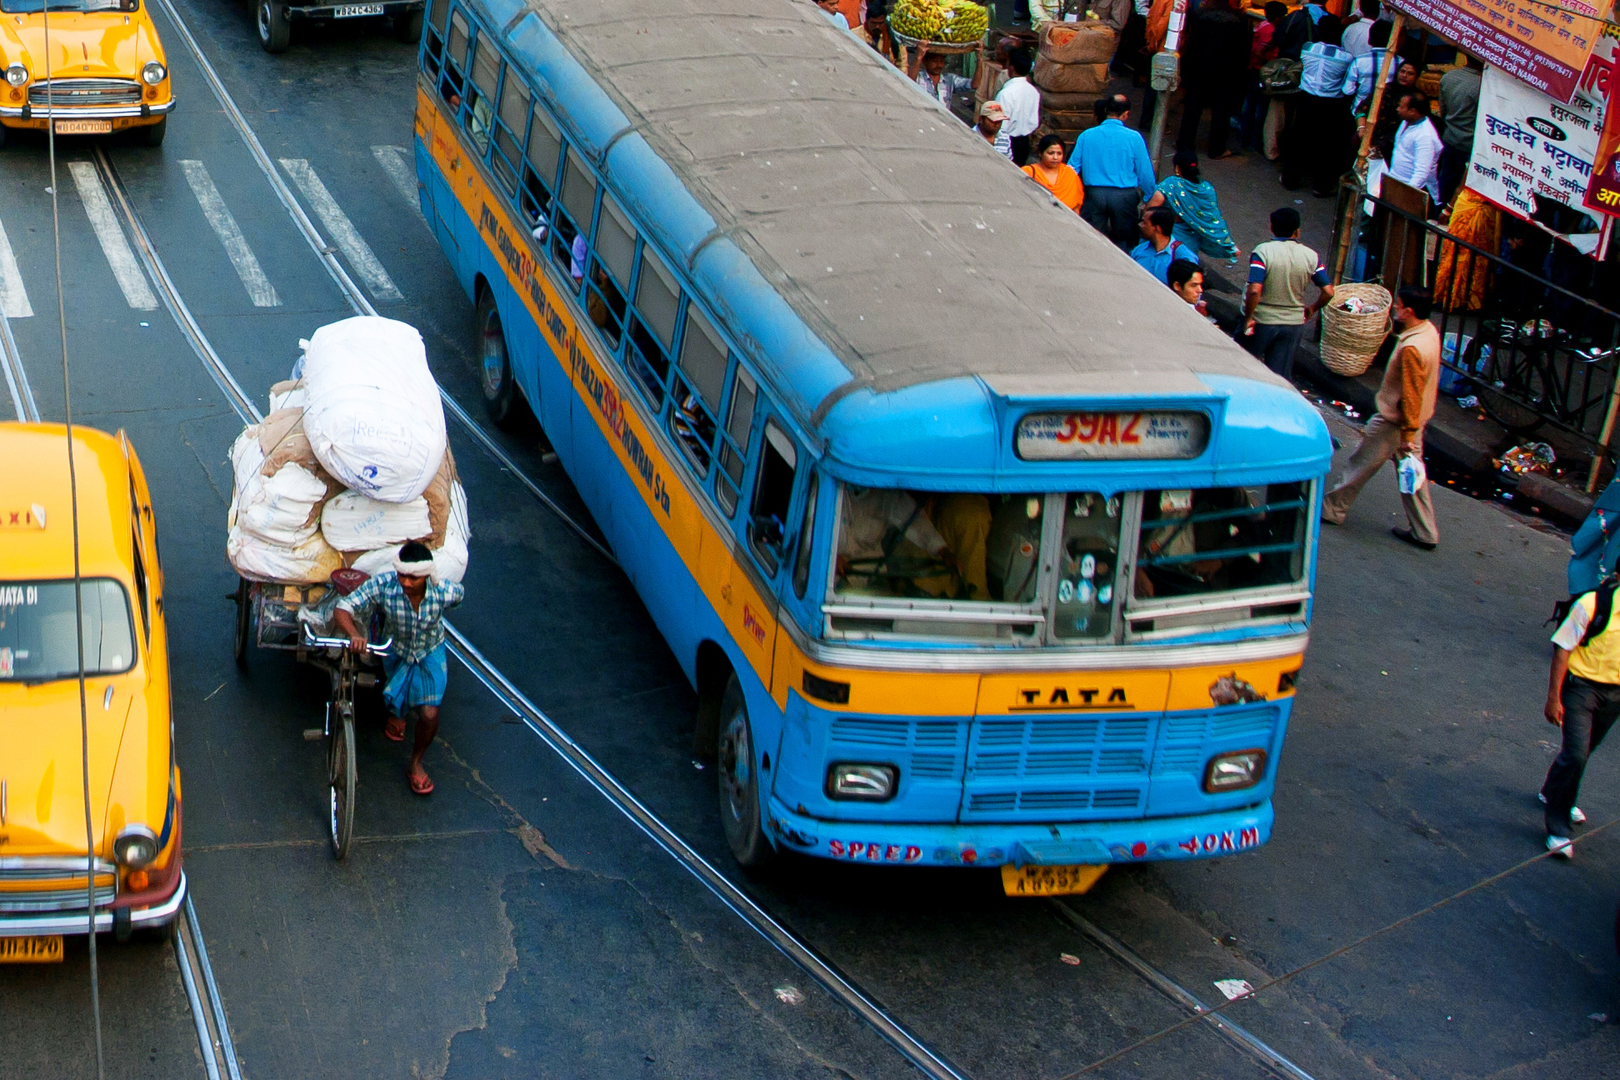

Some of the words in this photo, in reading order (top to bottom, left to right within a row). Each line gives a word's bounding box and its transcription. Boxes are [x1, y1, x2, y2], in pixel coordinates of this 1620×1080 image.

[1402, 1, 1444, 31] REGISTRATION
[1441, 23, 1457, 40] FEES
[1460, 35, 1472, 47] NO
[1470, 41, 1503, 65] CHARGES
[1502, 58, 1518, 72] FOR
[1517, 67, 1549, 91] NAMDAN
[1486, 114, 1536, 149] बुद्धदेव
[1491, 142, 1513, 160] तपन
[1517, 151, 1536, 173] सेन,
[1502, 161, 1533, 184] श्यामल
[1474, 160, 1500, 181] काली
[1501, 175, 1522, 195] घोष,
[498, 225, 521, 277] GARDEN
[546, 301, 567, 351] COURT
[580, 355, 603, 408] BAZAR
[621, 421, 654, 491] HOWRAH
[1056, 413, 1144, 447] 39A2
[26, 585, 38, 605] DI
[1021, 687, 1127, 704] TATA
[829, 839, 923, 863] SPEED
